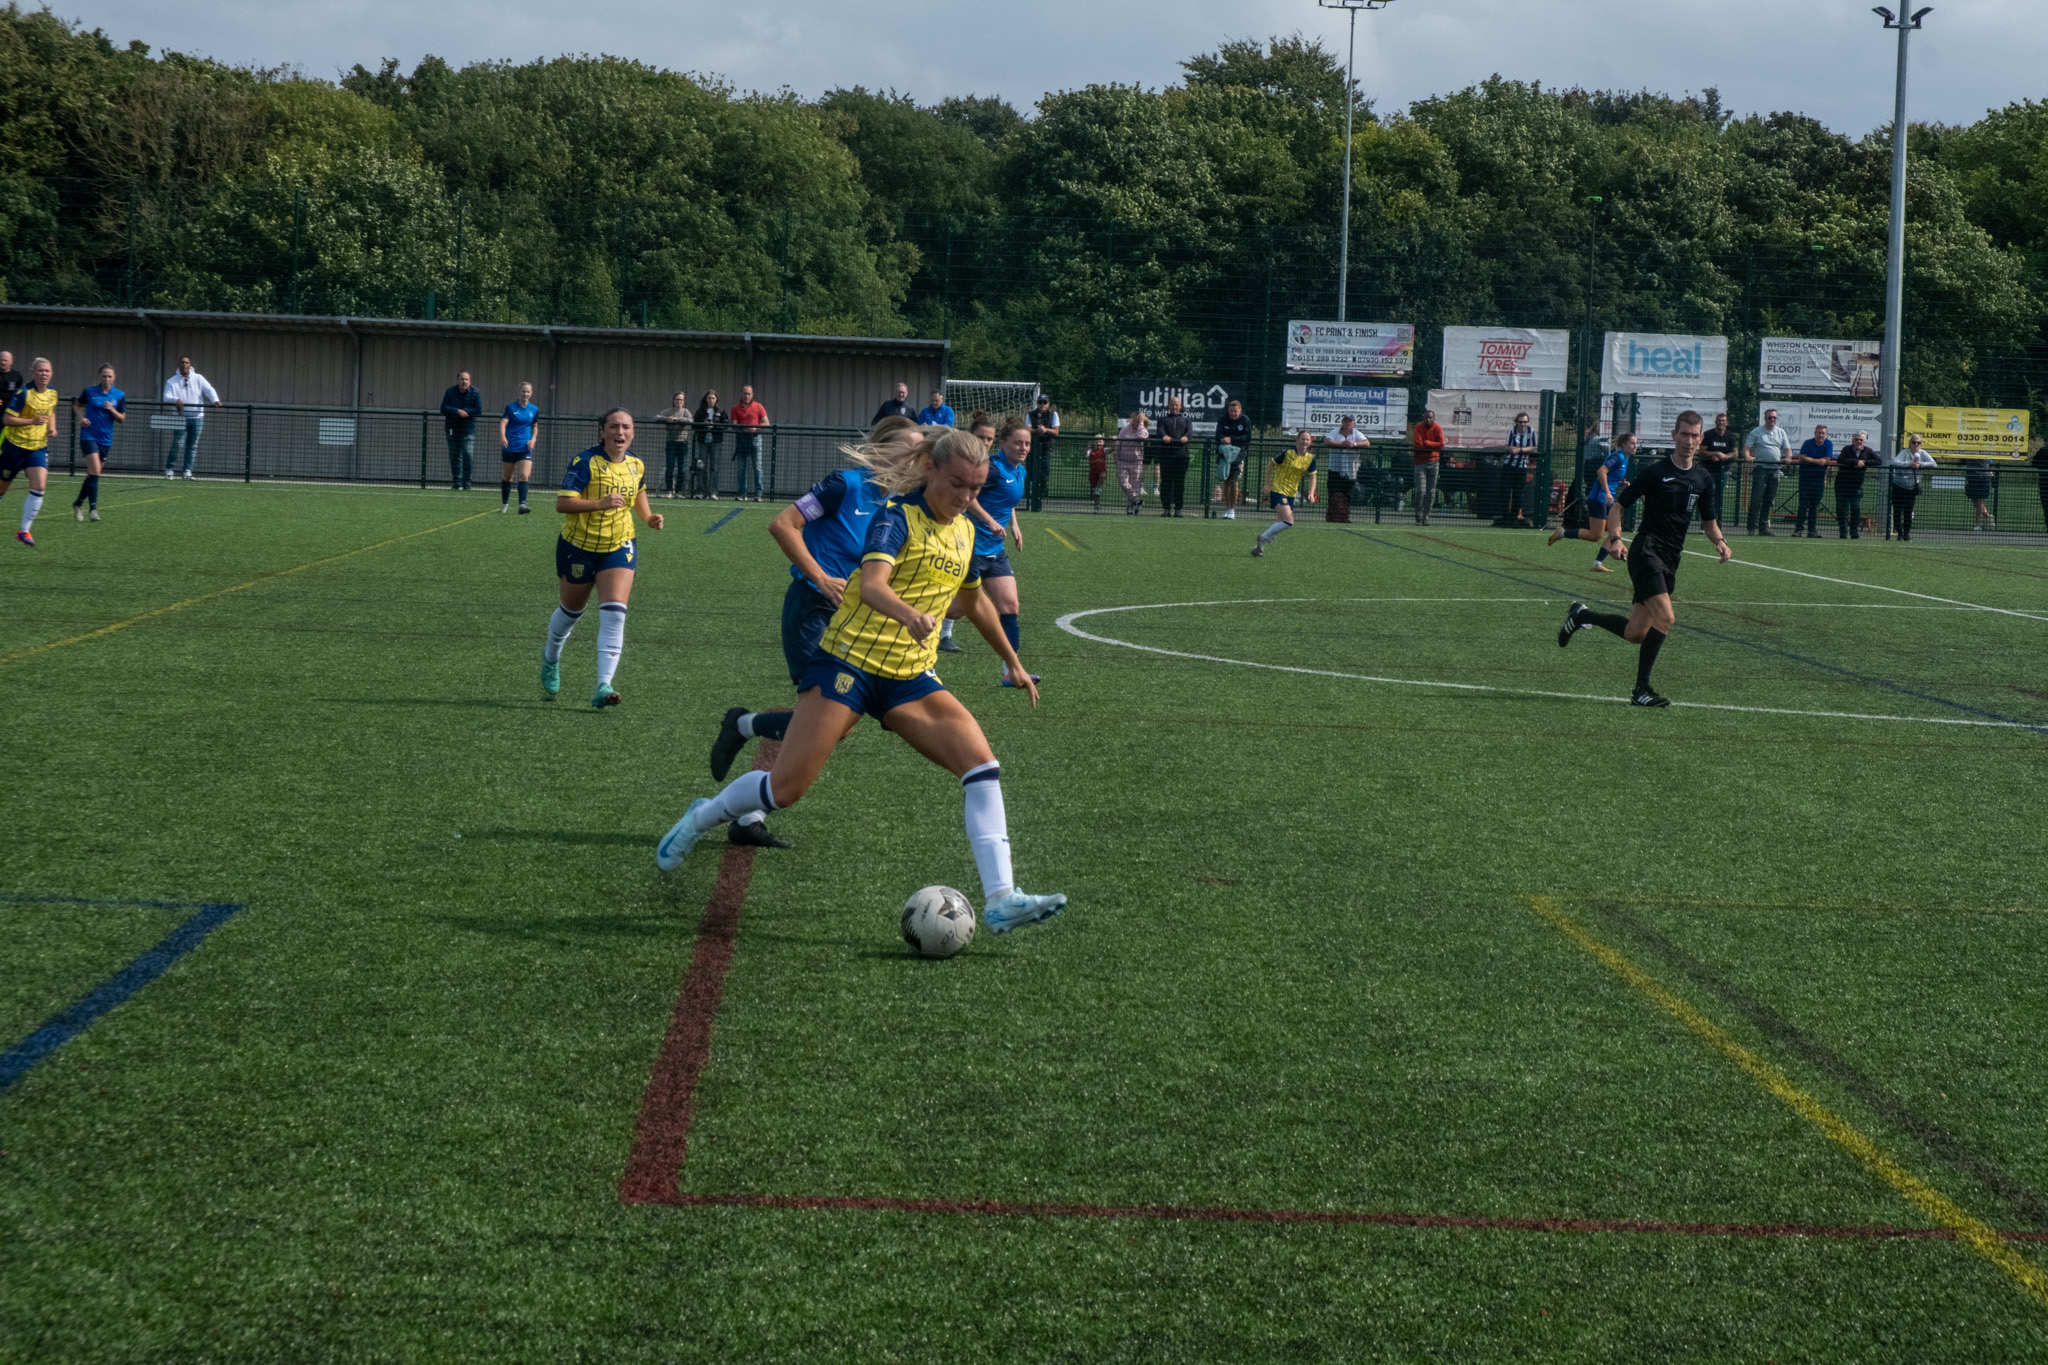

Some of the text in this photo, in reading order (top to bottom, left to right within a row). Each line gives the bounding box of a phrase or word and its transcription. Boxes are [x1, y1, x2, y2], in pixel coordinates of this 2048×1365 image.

[1316, 327, 1378, 337] FC PRINT & FINISH
[1479, 341, 1534, 358] TOMMY
[1628, 340, 1701, 373] heal
[1477, 356, 1518, 371] TYRES
[1309, 388, 1384, 400] Roby Glazing Ltd
[1311, 414, 1332, 423] 0151
[1357, 415, 1379, 424] 2313
[606, 482, 634, 496] idea
